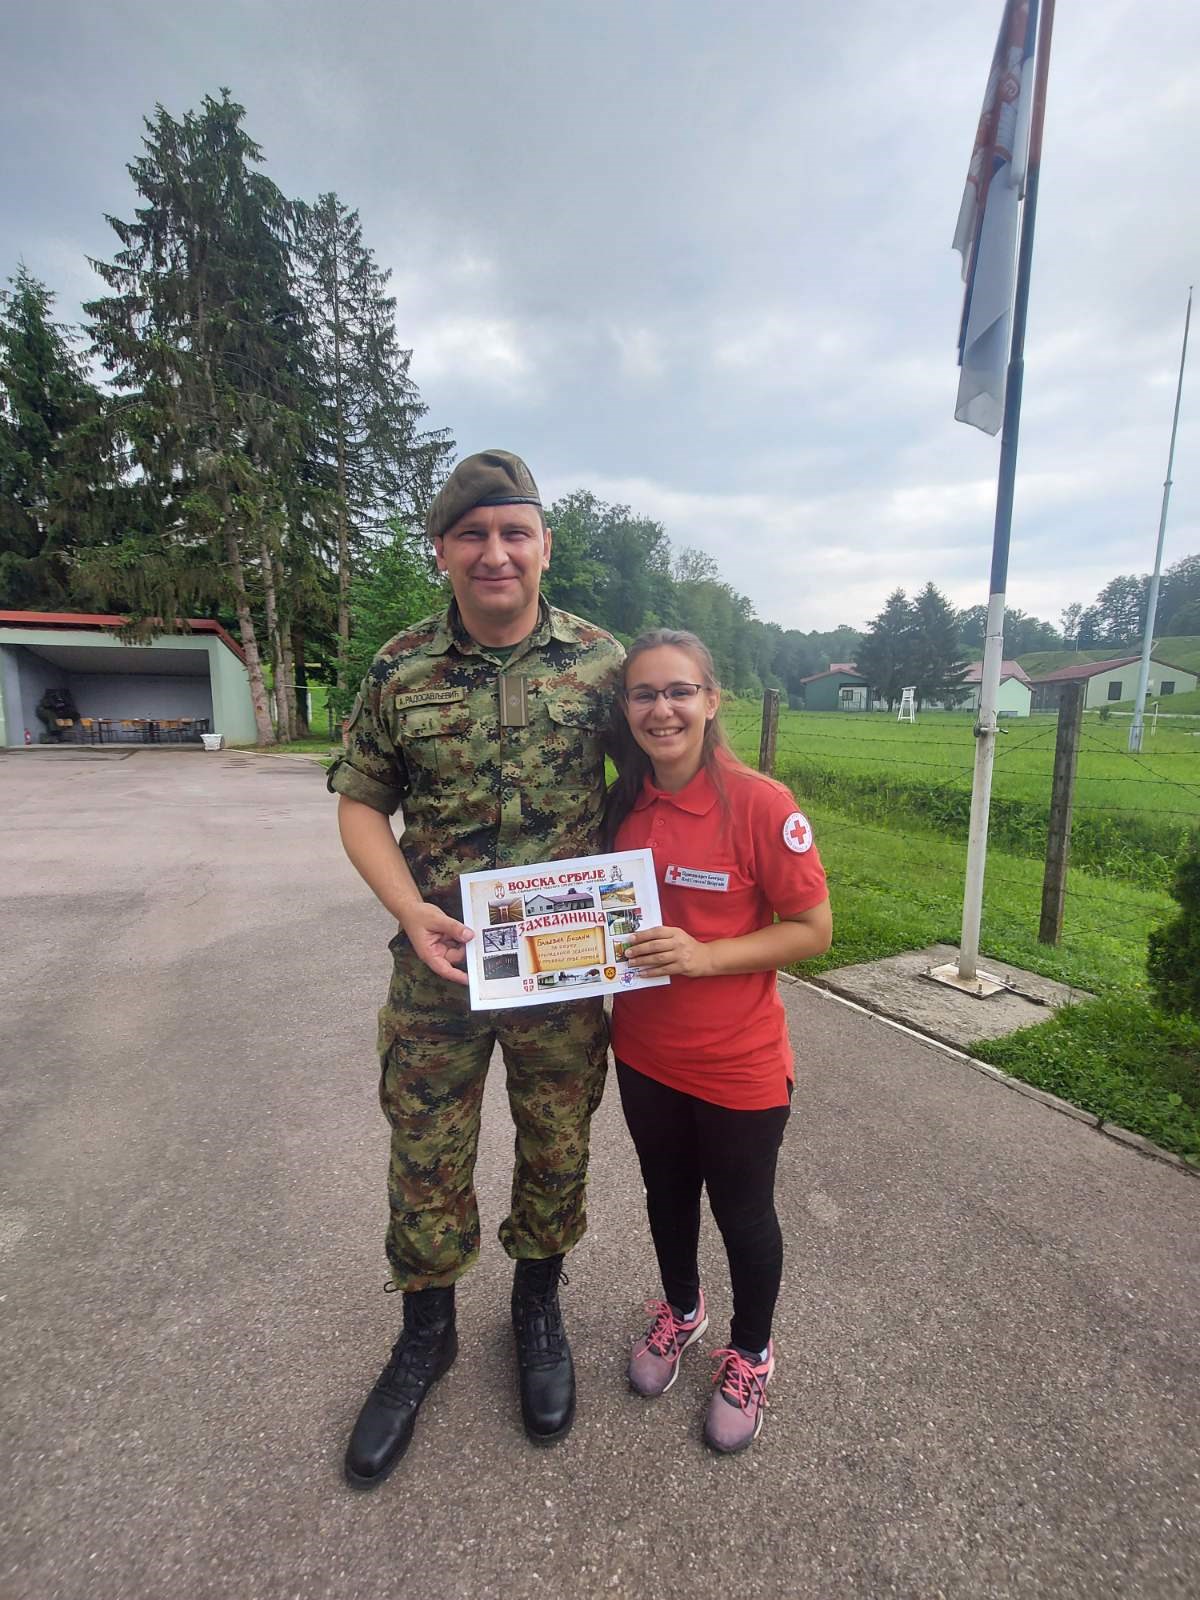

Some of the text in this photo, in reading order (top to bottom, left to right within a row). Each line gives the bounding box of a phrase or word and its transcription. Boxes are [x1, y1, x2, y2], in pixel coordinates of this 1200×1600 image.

[508, 877, 556, 891] ВОЈСКА
[559, 869, 605, 883] СРБИЈЕ
[518, 911, 606, 936] ЗАХВАЛНИЦА
